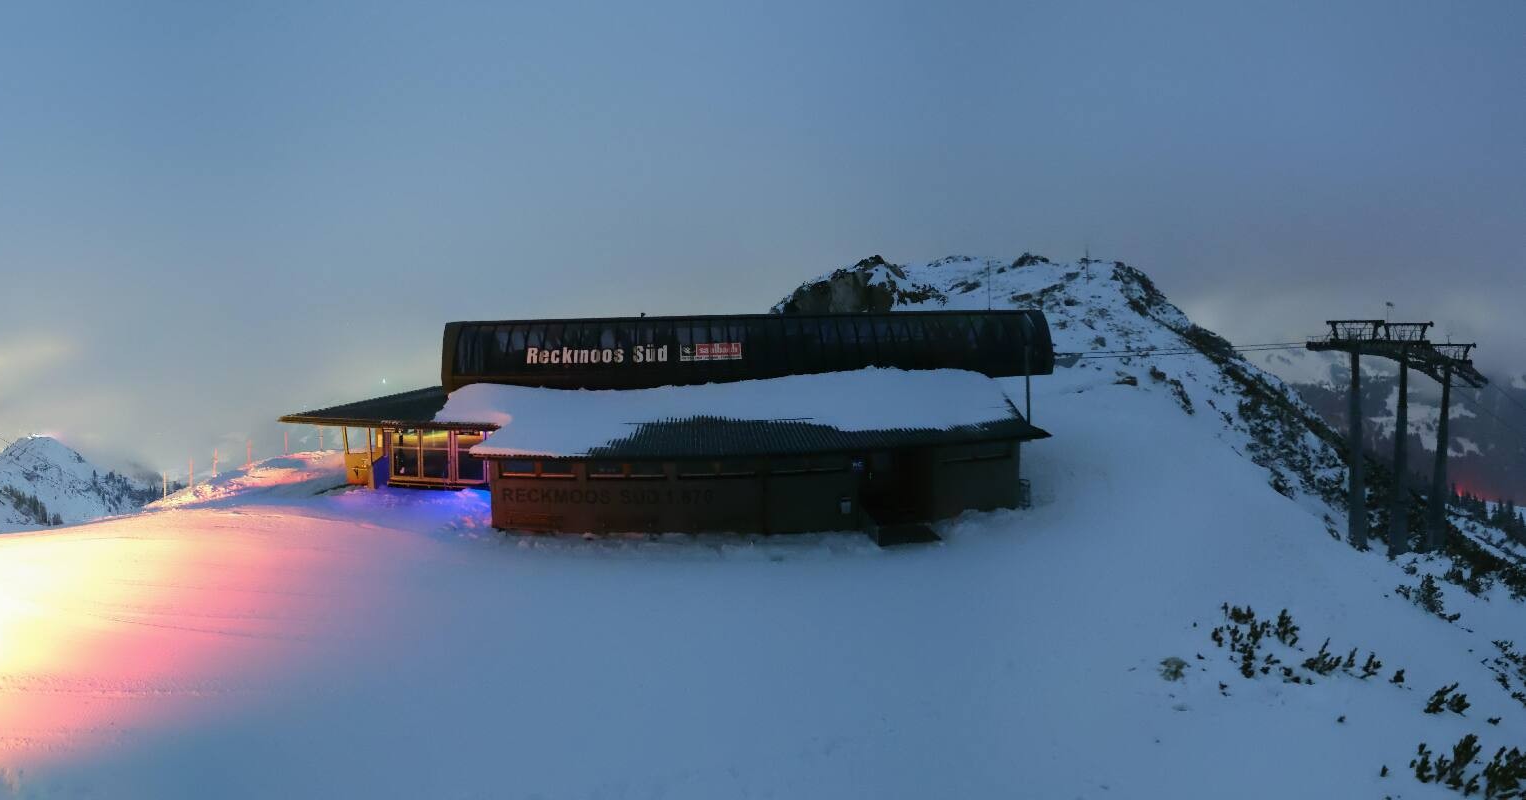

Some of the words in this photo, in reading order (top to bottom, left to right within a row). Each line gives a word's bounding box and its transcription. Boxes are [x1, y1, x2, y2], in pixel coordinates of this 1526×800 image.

[526, 346, 624, 365] Reckmoos
[632, 344, 668, 363] Süd
[501, 487, 612, 505] RECKMOOS
